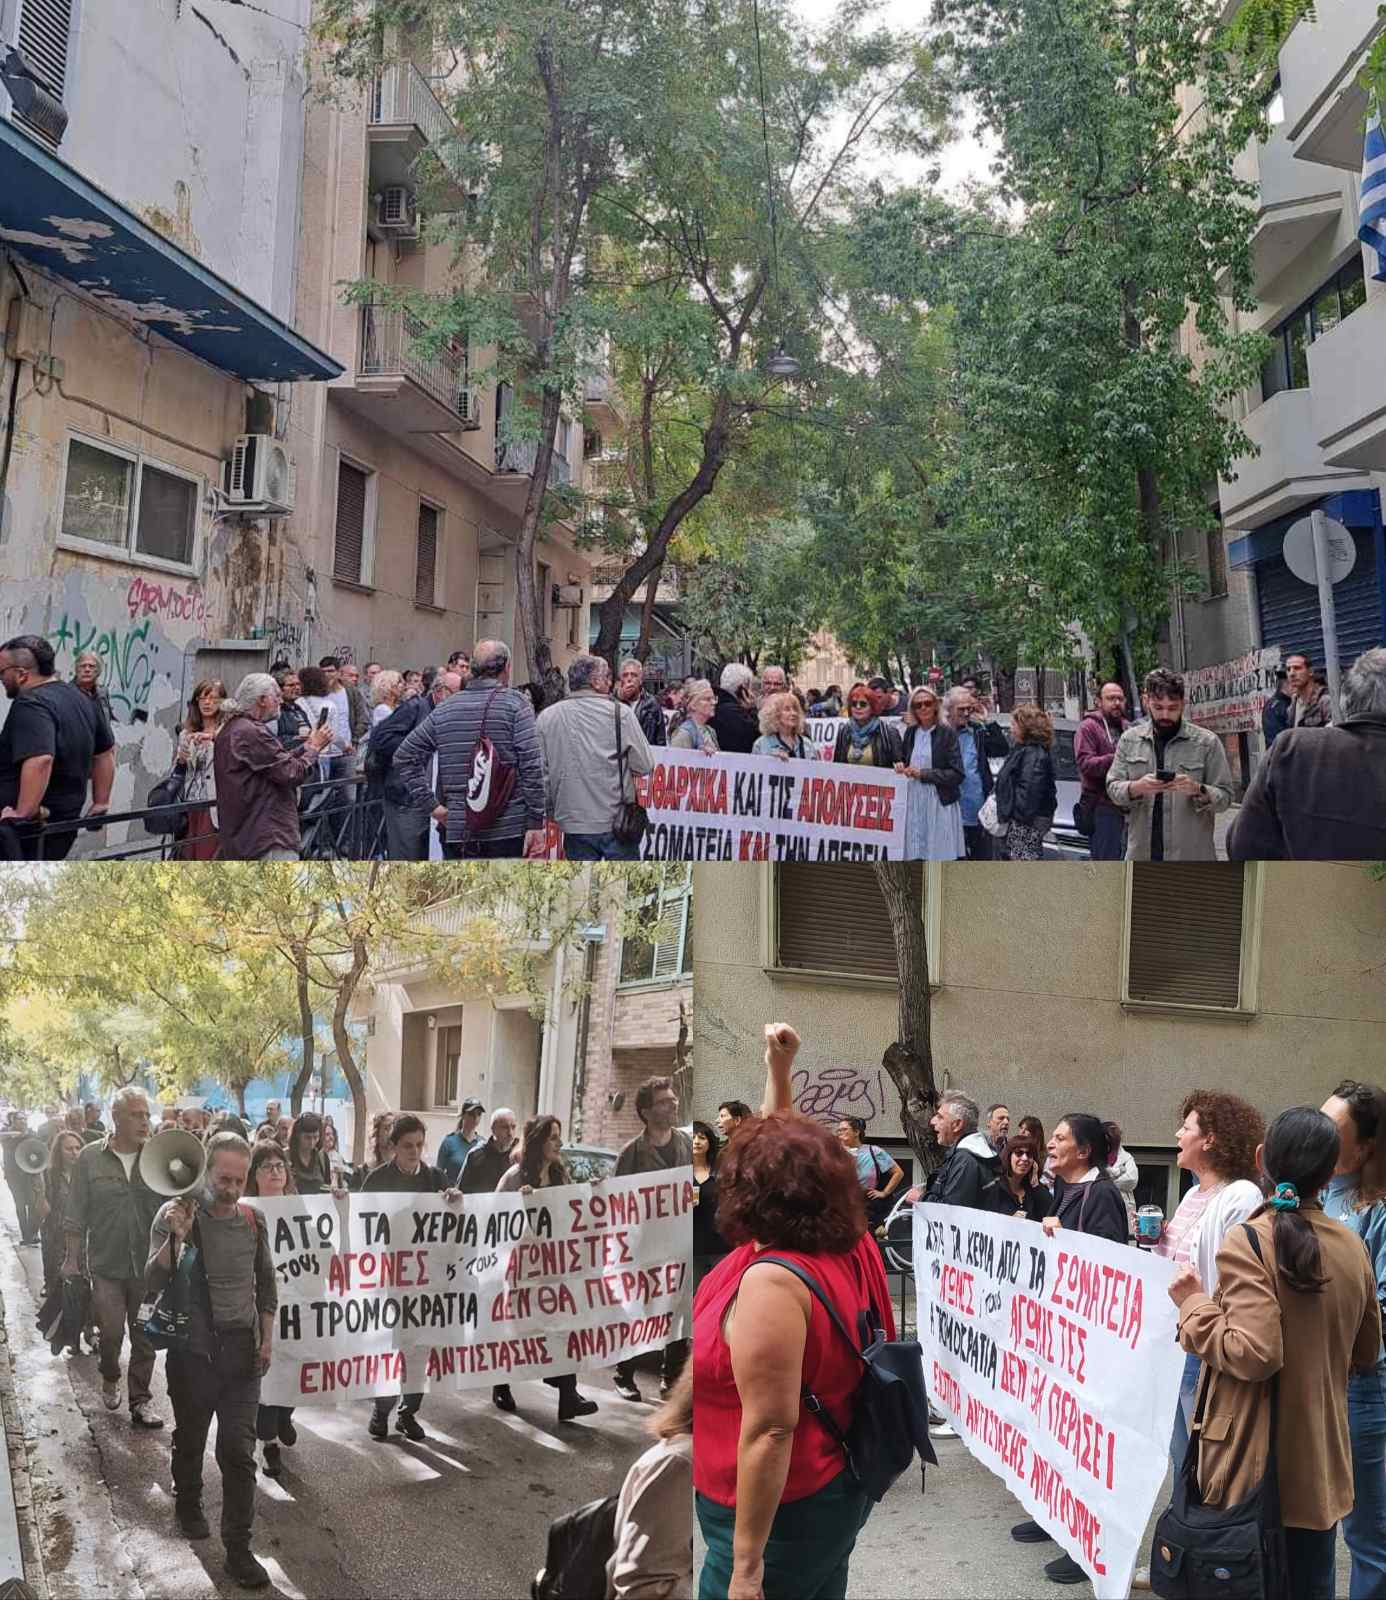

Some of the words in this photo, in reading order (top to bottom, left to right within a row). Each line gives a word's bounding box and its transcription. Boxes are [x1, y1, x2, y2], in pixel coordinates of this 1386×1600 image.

[634, 763, 728, 815] ΕΙΘΑΡΧΙΚΑ
[733, 771, 763, 817] ΚΑΙ
[769, 774, 795, 820] ΤΙΣ
[797, 777, 896, 832] ΑΠΟΛΥΣΕΙΣ
[738, 830, 770, 861] ΚΑΙ
[776, 834, 810, 861] ΤΗΝ
[359, 1212, 391, 1245] ΤΑ
[411, 1211, 478, 1247] ΧΕΡΙΑ
[484, 1208, 524, 1248] ΑΠΟ
[569, 1180, 693, 1233] ΣΩΜΑΤΕΙΑ
[328, 1250, 430, 1297] ΑΓΩΝΕΣ
[505, 1231, 633, 1288] ΑΓΩΝΙΣΤΕΣ
[966, 1229, 994, 1279] ΧΕΡΙΑ
[996, 1239, 1020, 1285] ΑΠΟ
[1028, 1246, 1045, 1298] ΤΑ
[1050, 1251, 1143, 1350] ΣΩΜΑΤΕΙΑ
[280, 1304, 301, 1340] Η
[310, 1292, 478, 1338] ΤΡΟΜΟΚΡΑΤΙΑ
[491, 1287, 530, 1322] ΔΕΝ
[538, 1283, 577, 1315] ΘΑ
[585, 1263, 686, 1309] ΠΕΡΑΣΕΙ
[300, 1351, 407, 1394] ΕΝΟΤΗΤΑ
[426, 1336, 552, 1382] ΑΝΤΙΣΤΑΣΗΣ
[567, 1311, 674, 1362] ΑΝΑΤΡΟΠΗΣ
[1000, 1350, 1027, 1402] ΔΕΝ
[1048, 1382, 1115, 1490] ΠΕΡΑΣΕΙ
